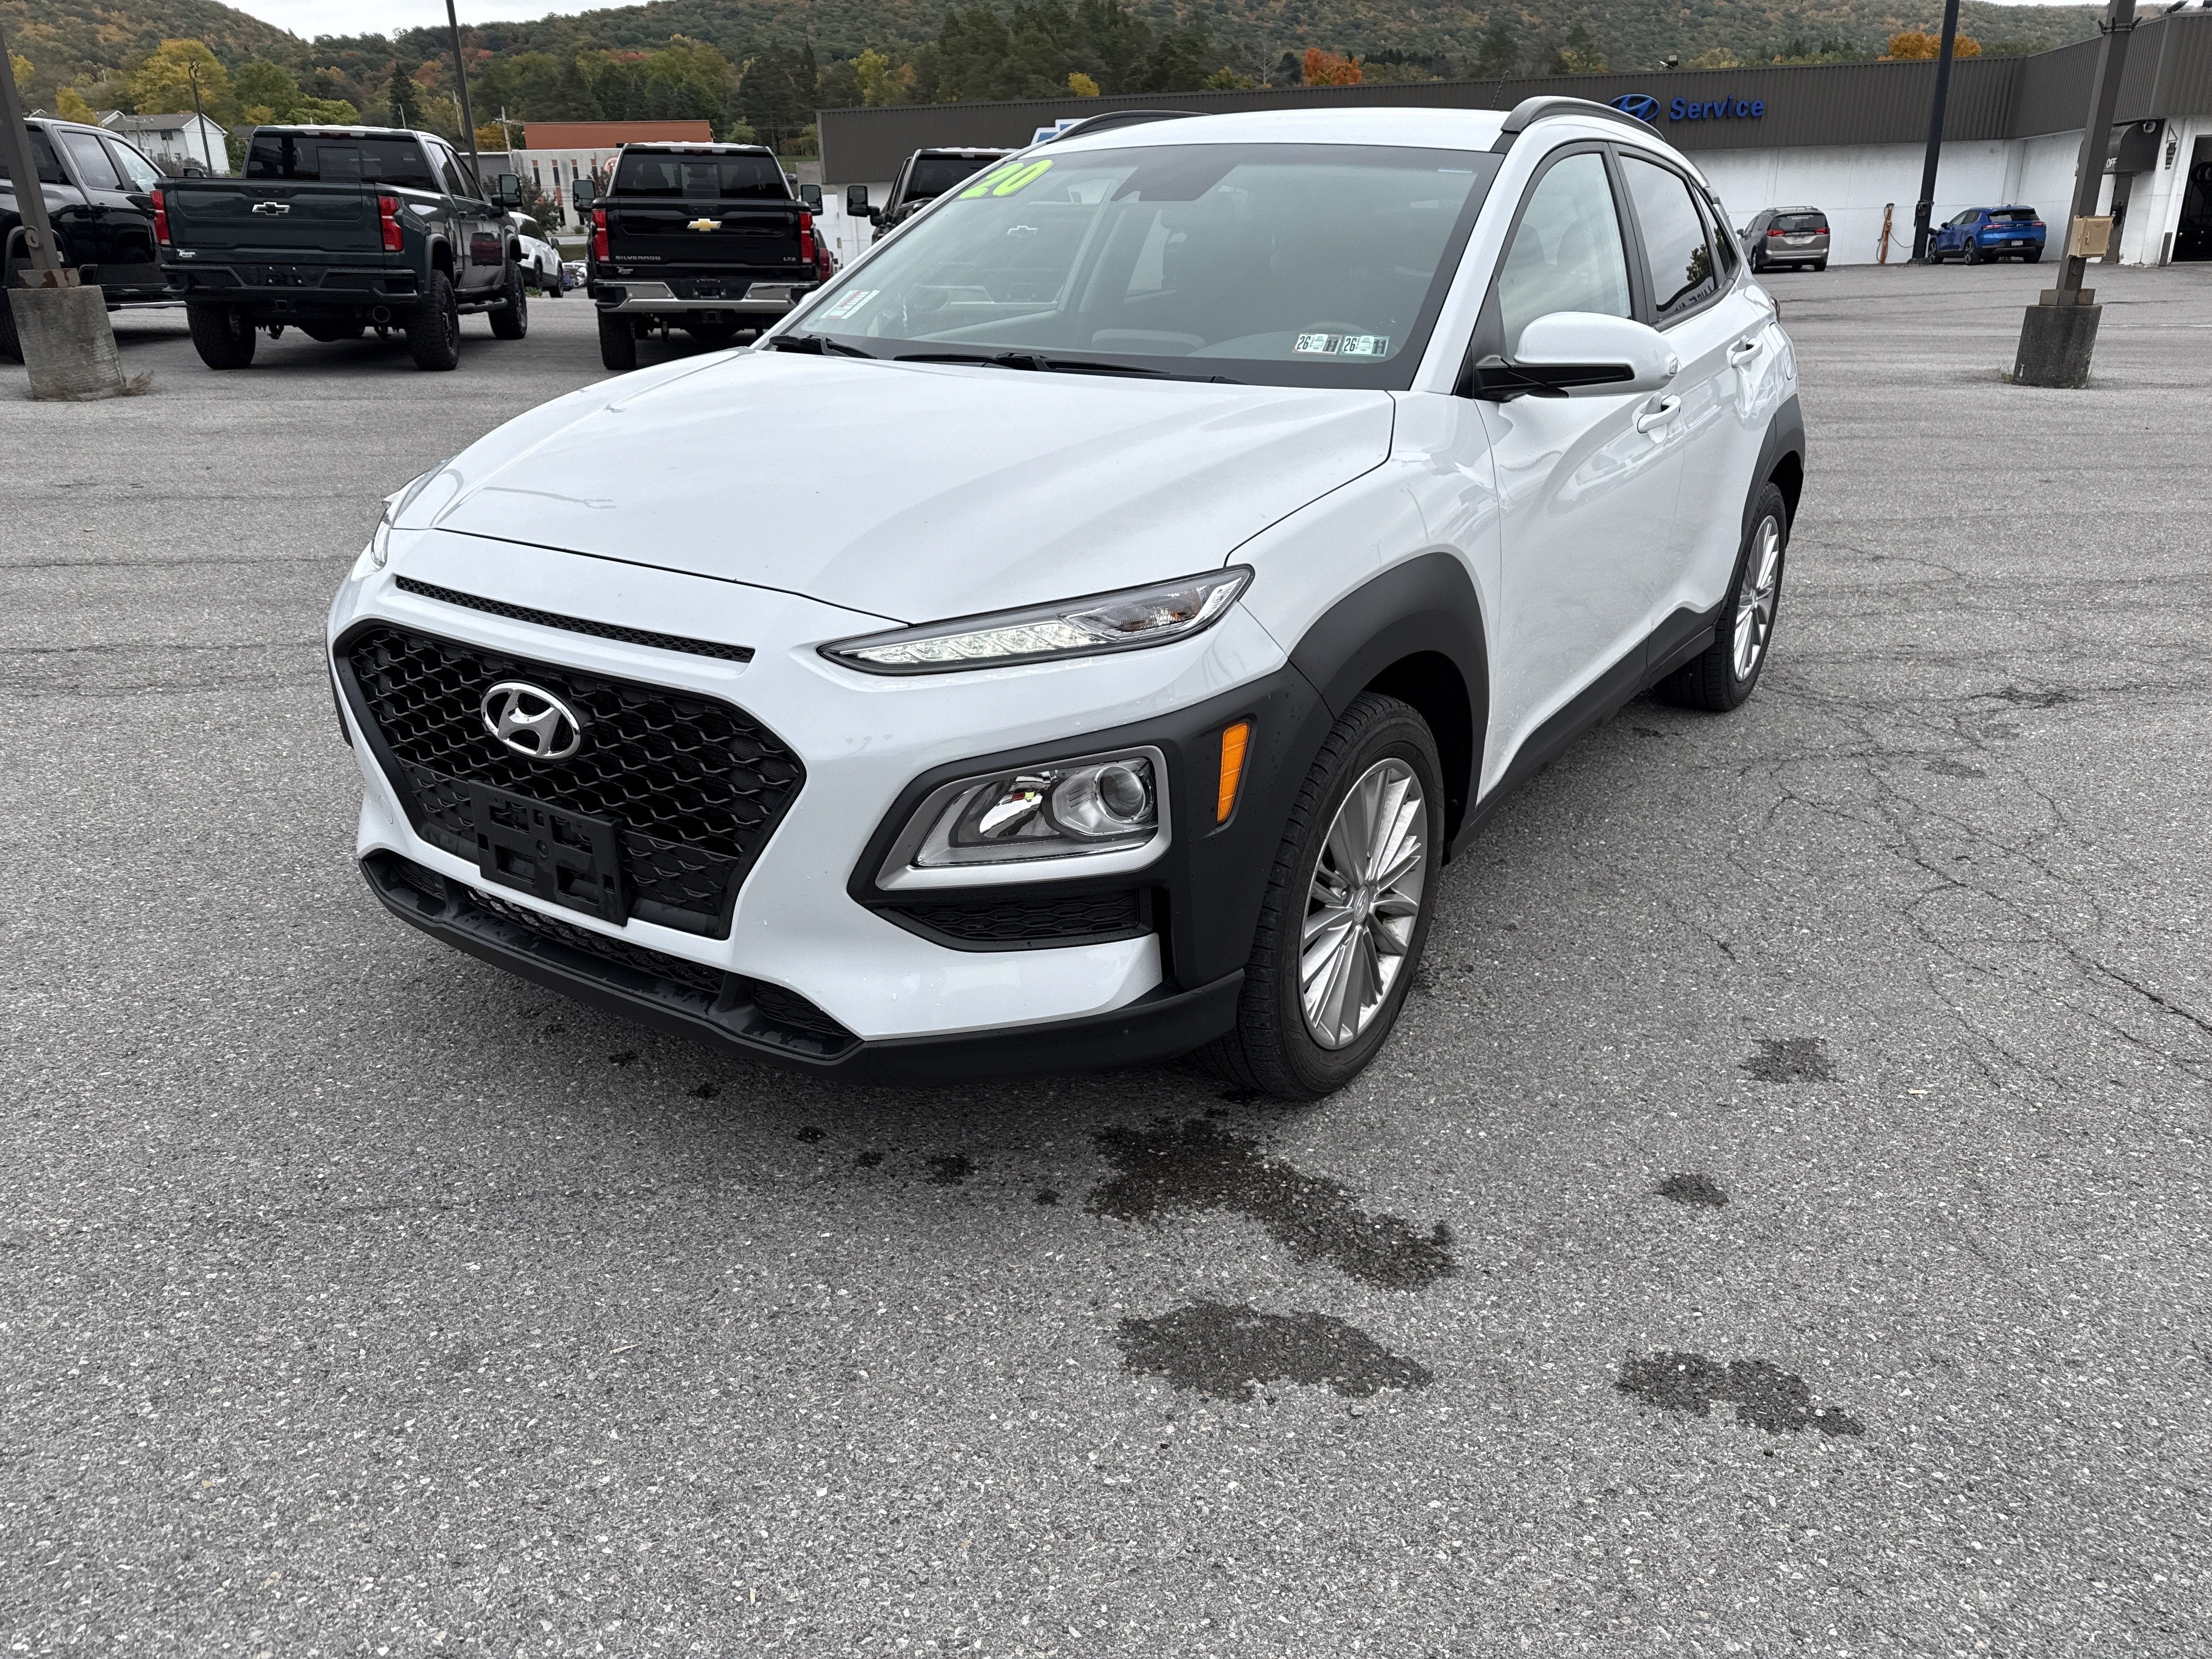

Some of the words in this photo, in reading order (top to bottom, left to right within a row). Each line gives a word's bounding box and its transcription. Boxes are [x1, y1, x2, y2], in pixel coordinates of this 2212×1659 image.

[1669, 94, 1765, 120] Service
[2106, 157, 2118, 168] OFF
[958, 159, 1054, 199] 20
[1296, 336, 1311, 350] 26
[1325, 339, 1339, 352] 11
[1343, 337, 1357, 352] 26
[1373, 340, 1387, 354] 11
